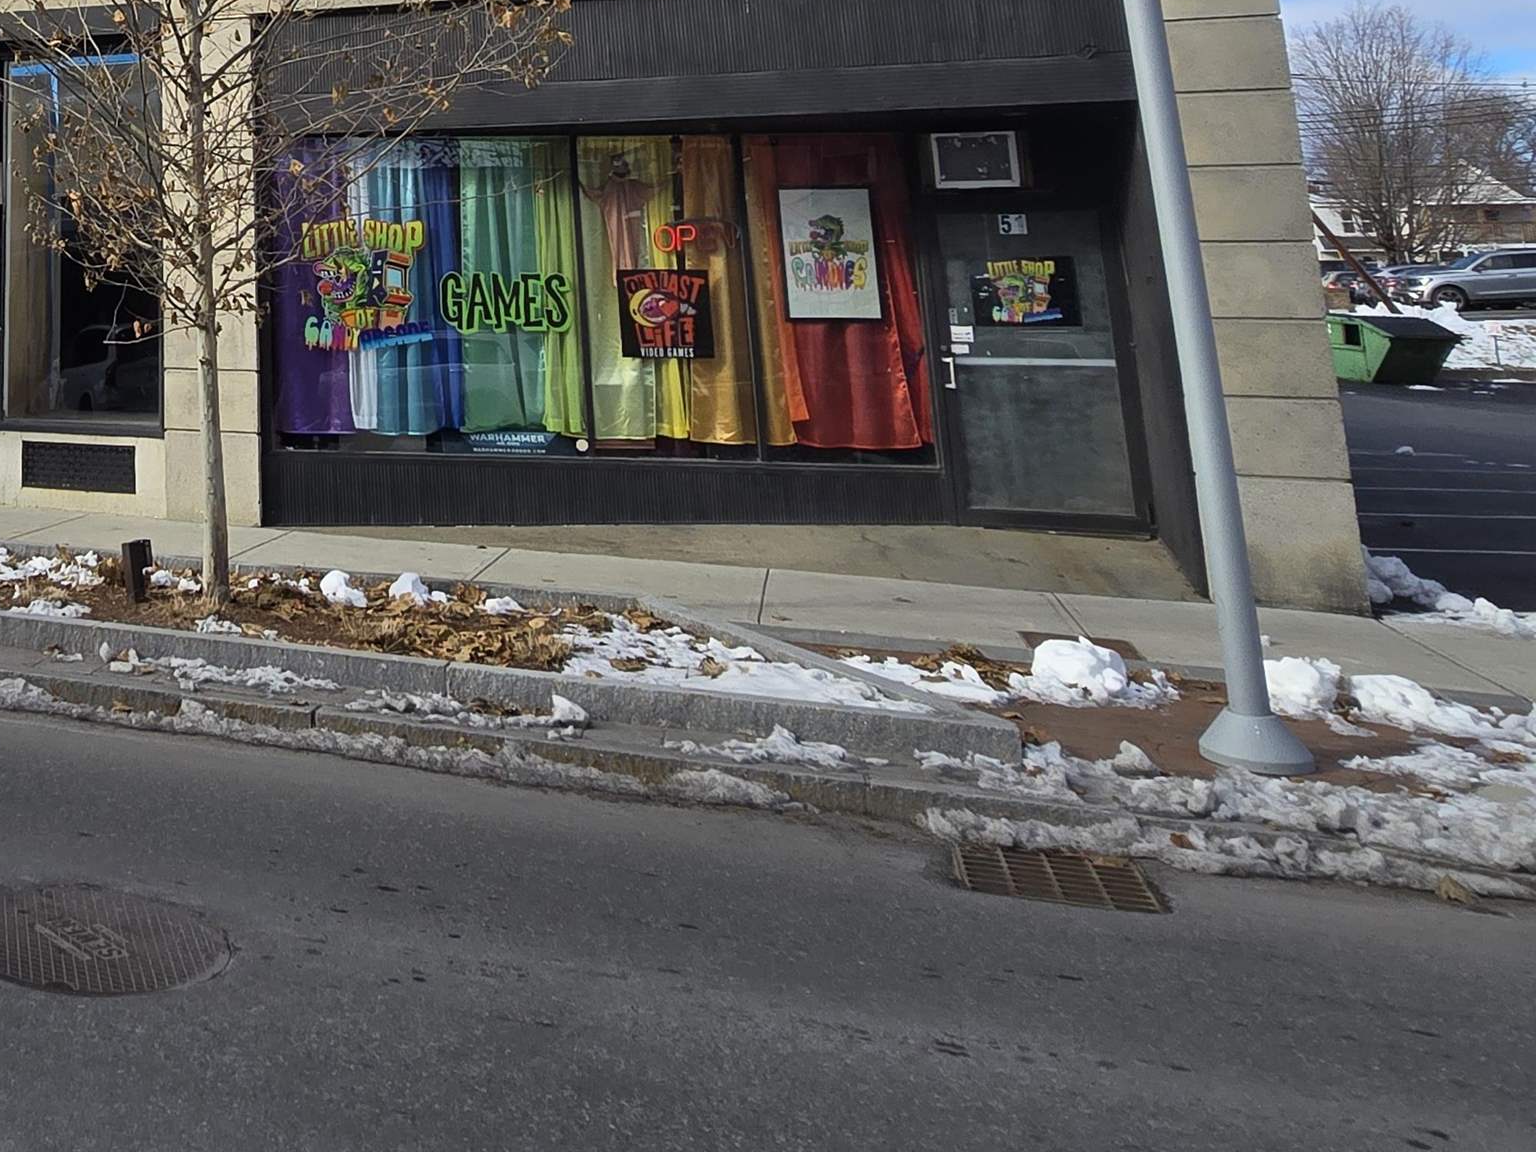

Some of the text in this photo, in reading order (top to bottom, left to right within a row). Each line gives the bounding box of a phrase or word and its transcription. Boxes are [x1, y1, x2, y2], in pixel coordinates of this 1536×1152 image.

[301, 219, 426, 260] LITTLE SHOP
[440, 271, 570, 333] GAMES
[640, 347, 695, 358] VIDEO GAMES
[470, 433, 546, 444] WARHAMMER
